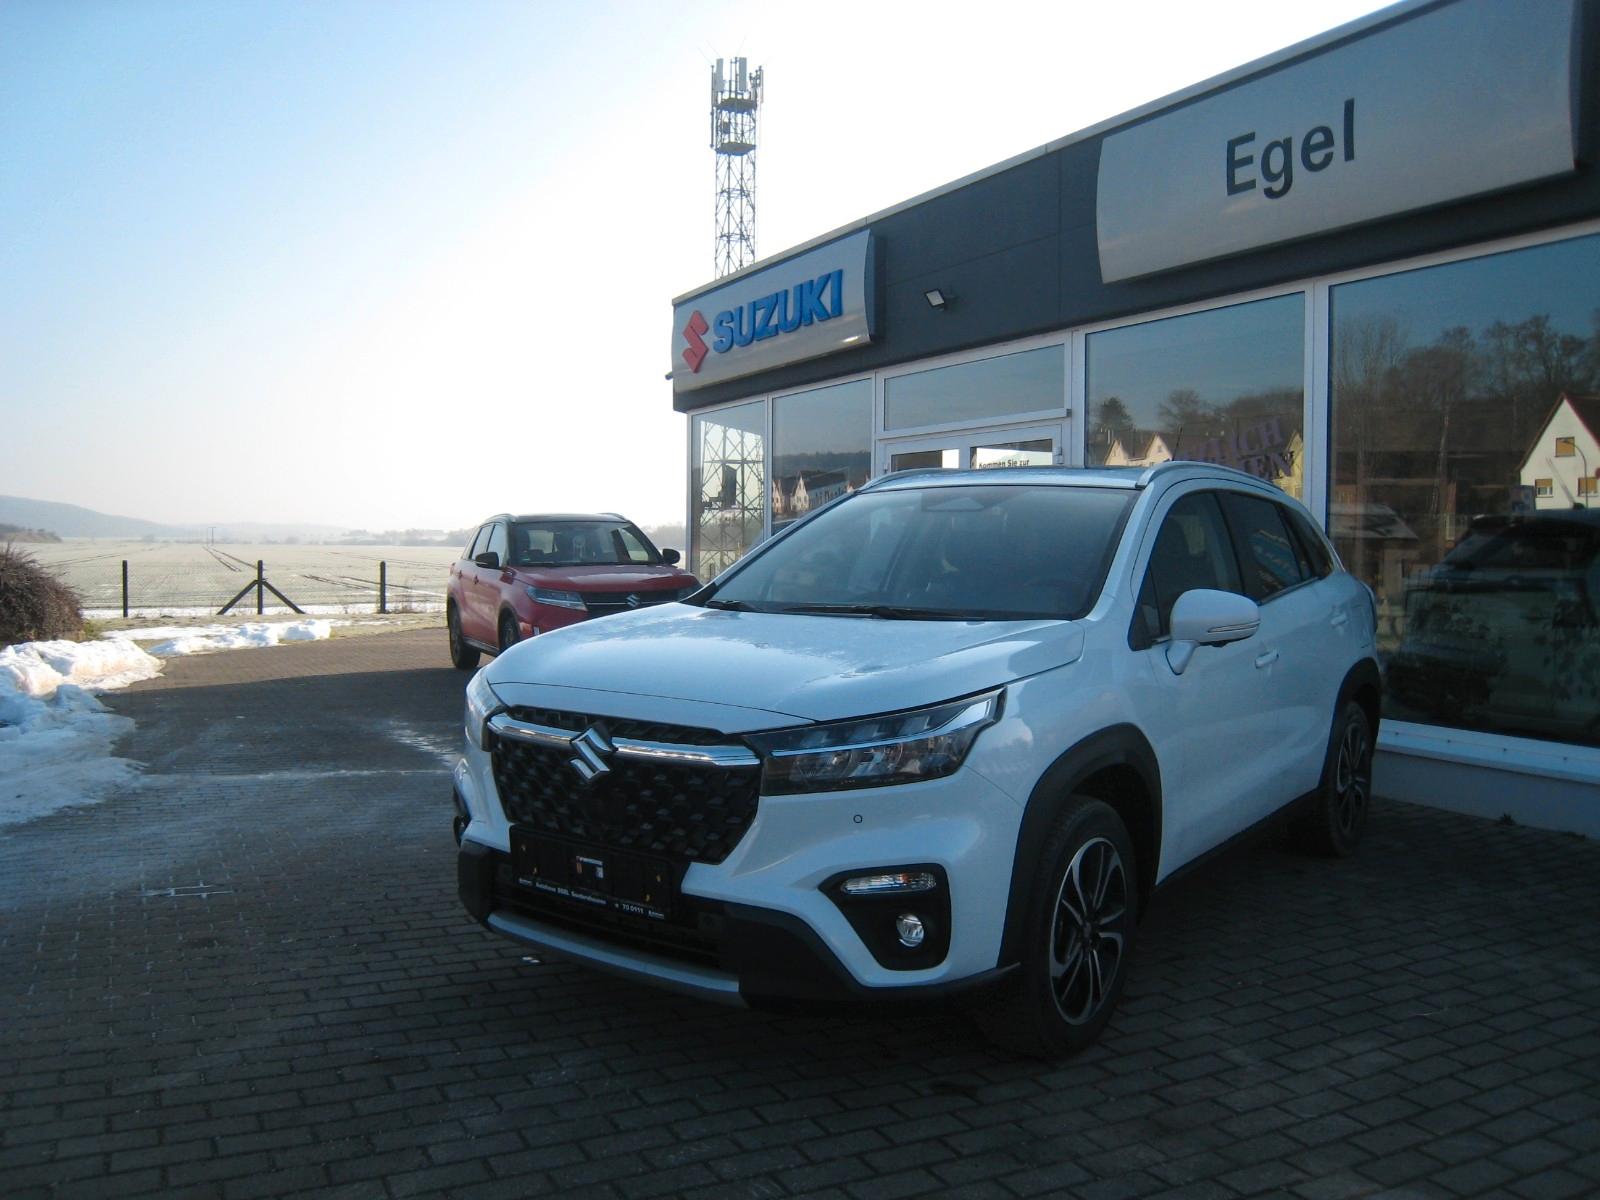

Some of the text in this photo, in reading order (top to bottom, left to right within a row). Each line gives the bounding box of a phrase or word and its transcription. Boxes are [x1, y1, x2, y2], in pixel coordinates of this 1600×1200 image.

[1226, 97, 1355, 200] Egel
[713, 269, 843, 353] SUZUKI
[1007, 458, 1018, 467] Sie
